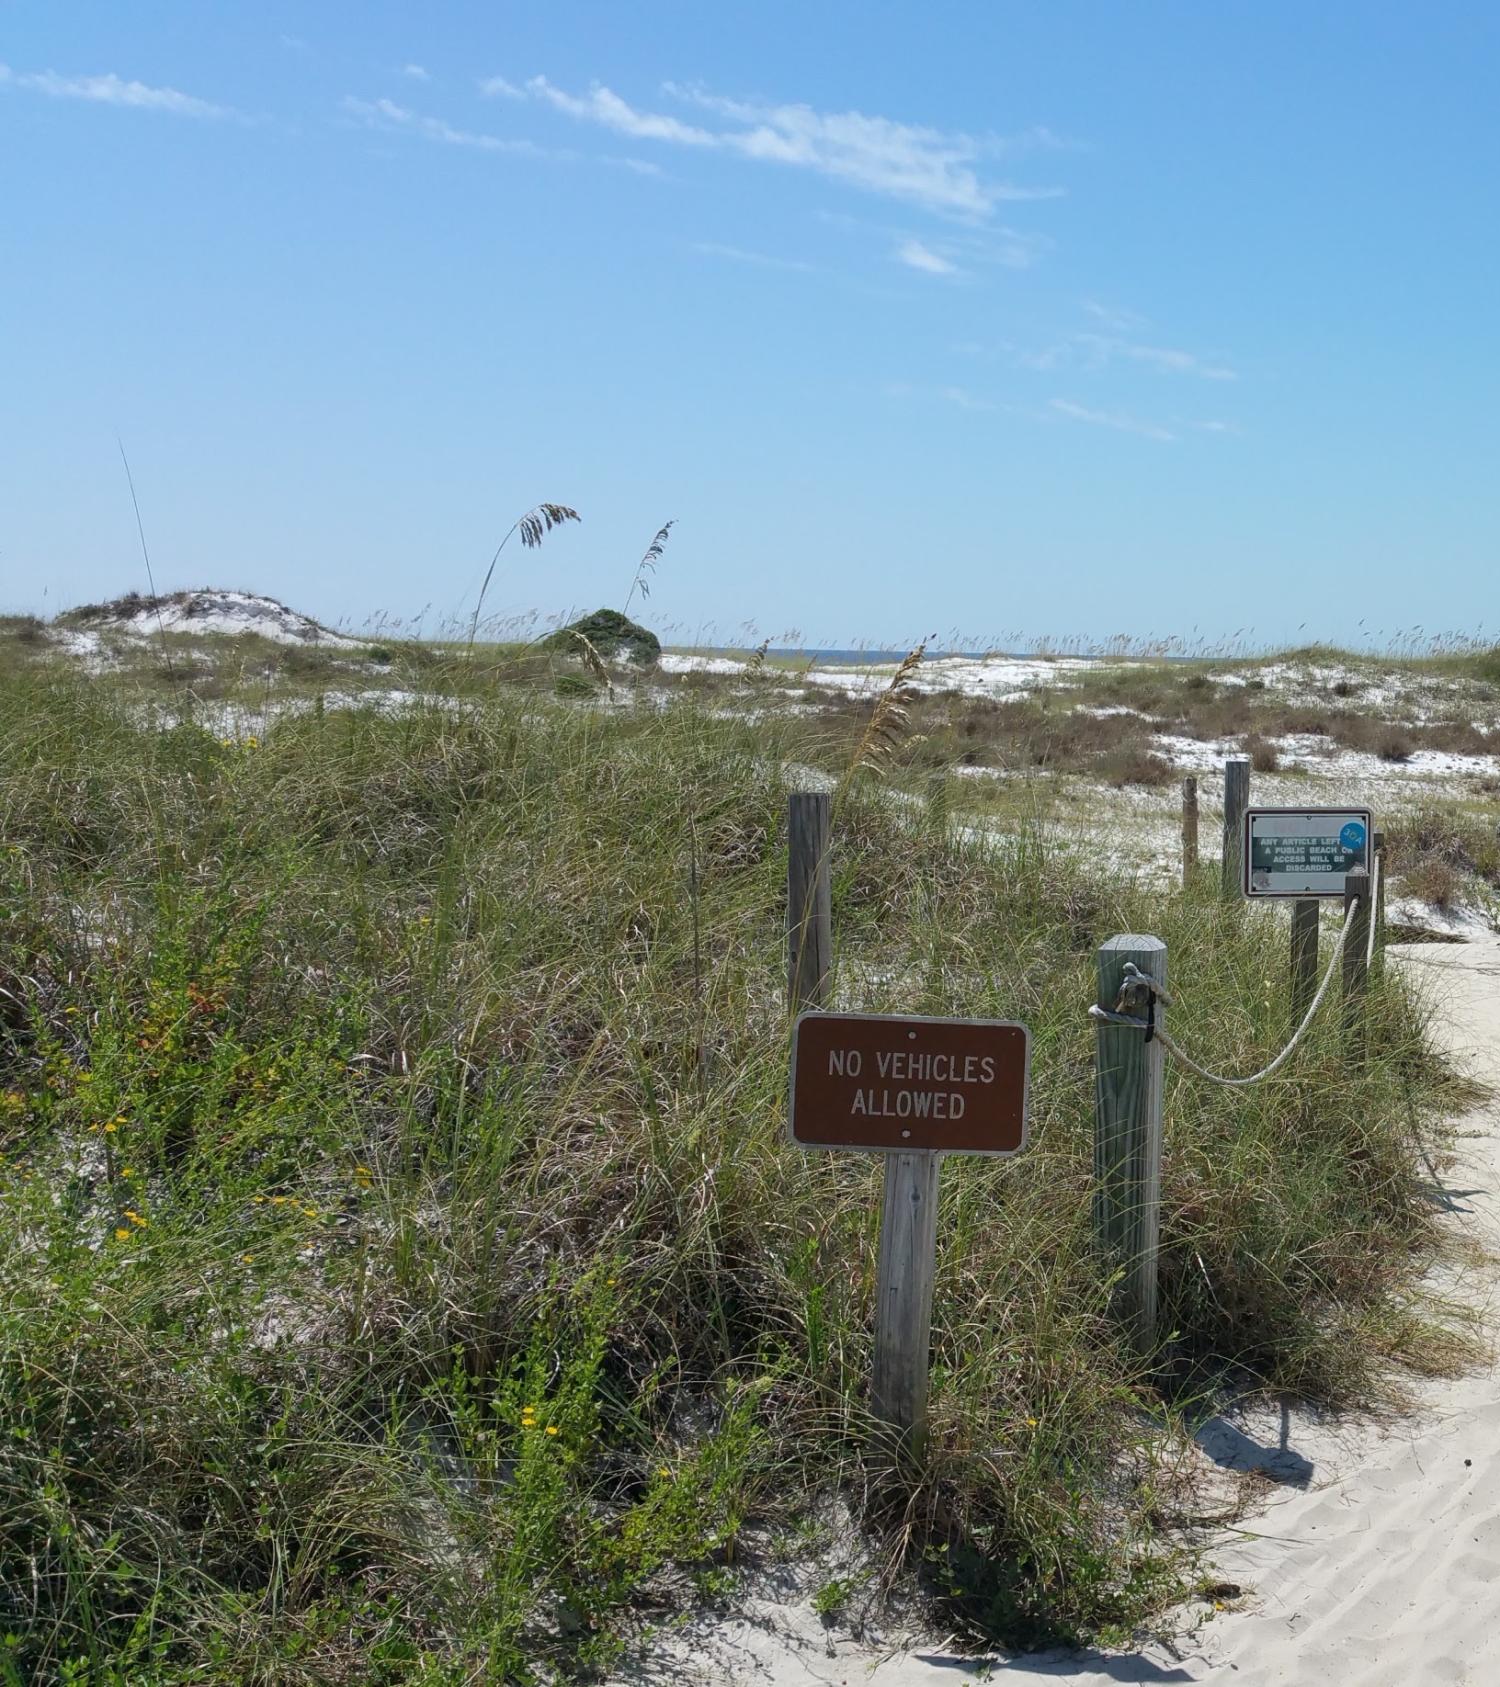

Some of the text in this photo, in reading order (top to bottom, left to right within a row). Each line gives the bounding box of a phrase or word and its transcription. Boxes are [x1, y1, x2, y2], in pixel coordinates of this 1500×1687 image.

[829, 1050, 995, 1083] NO VEHICLES
[851, 1089, 965, 1119] ALLOWED
